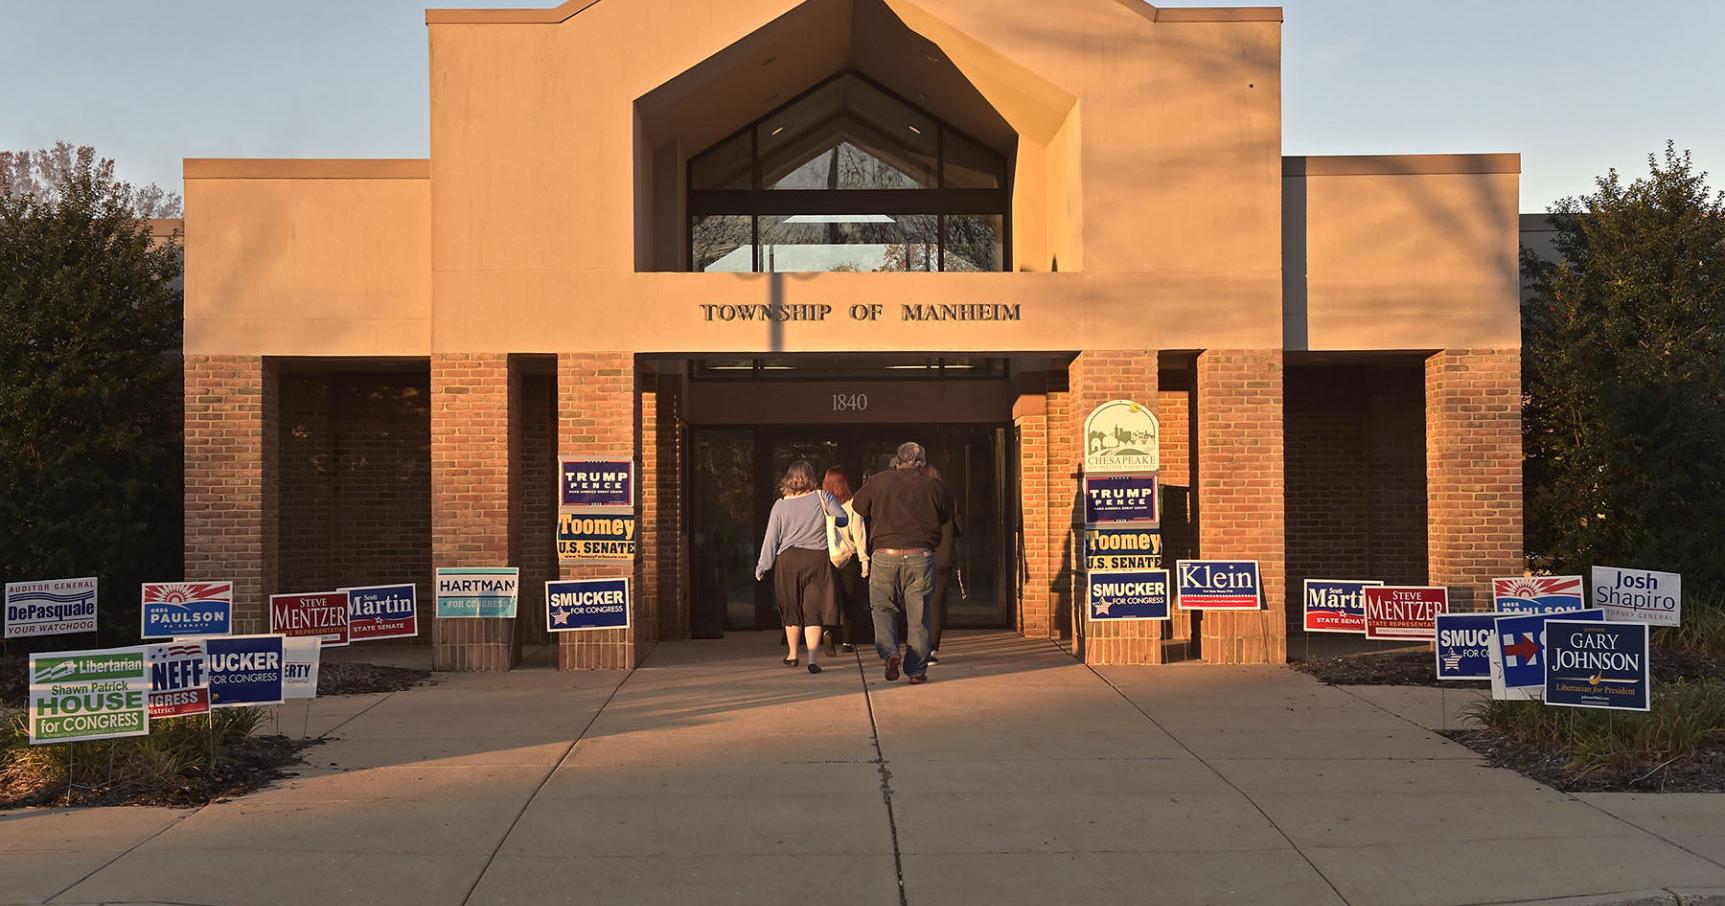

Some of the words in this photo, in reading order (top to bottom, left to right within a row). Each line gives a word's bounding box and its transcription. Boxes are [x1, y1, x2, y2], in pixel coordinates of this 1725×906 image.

[700, 303, 832, 321] TOWNSHIP
[849, 303, 883, 321] OF
[902, 303, 1022, 321] MANHEIM
[831, 393, 868, 412] 1840
[1087, 456, 1156, 466] CHESAPEAKE
[565, 472, 628, 482] TRUMP
[1089, 488, 1152, 499] TRUMP
[1095, 498, 1146, 506] PENCE
[559, 513, 635, 541] Toomey
[559, 542, 581, 554] U.S.
[584, 542, 635, 554] SENATE
[1086, 530, 1161, 554] Toomey
[1086, 556, 1109, 569] U.S.
[1111, 556, 1162, 569] SENATE
[1180, 565, 1253, 589] Klein
[1615, 571, 1658, 590] Josh
[9, 583, 50, 593] AUDITOR
[54, 581, 94, 590] GENERAL
[440, 580, 515, 592] HARTMAN
[1092, 582, 1165, 597] SMUCKER
[300, 597, 328, 608] STEVE
[550, 590, 624, 608] SMUCKER
[1113, 596, 1126, 604] FOR
[1127, 596, 1165, 604] CONGRESS
[1308, 587, 1364, 609] Marti
[1392, 590, 1422, 600] STEVE
[1596, 585, 1675, 612] Shapiro
[8, 598, 95, 621] DePasquale
[348, 594, 412, 616] Martin
[447, 600, 464, 608] FOR
[570, 606, 585, 615] FOR
[585, 604, 623, 614] CONGRESS
[1368, 595, 1443, 621] MENTZER
[150, 611, 224, 624] PAULSON
[273, 603, 347, 630] MENTZER
[1638, 613, 1673, 621] GENERAL
[8, 625, 35, 635] YOUR
[39, 621, 94, 631] WATCHDOG
[353, 625, 376, 633] STATE
[377, 623, 405, 631] SENATE
[1570, 632, 1619, 650] GARY
[1463, 649, 1479, 658] FOR
[1552, 648, 1639, 672] JOHNSON
[79, 657, 142, 674] Libertarian
[208, 651, 279, 673] UCKER
[152, 659, 204, 692] NEFF
[208, 674, 227, 685] FOR
[229, 672, 278, 684] CONGRESS
[51, 684, 89, 696] Shawn
[91, 681, 128, 693] Patrick
[1556, 683, 1592, 693] Libertarian
[1604, 686, 1636, 696] President
[37, 691, 143, 716] HOUSE
[41, 719, 60, 733] for
[63, 712, 139, 732] CONGRESS
